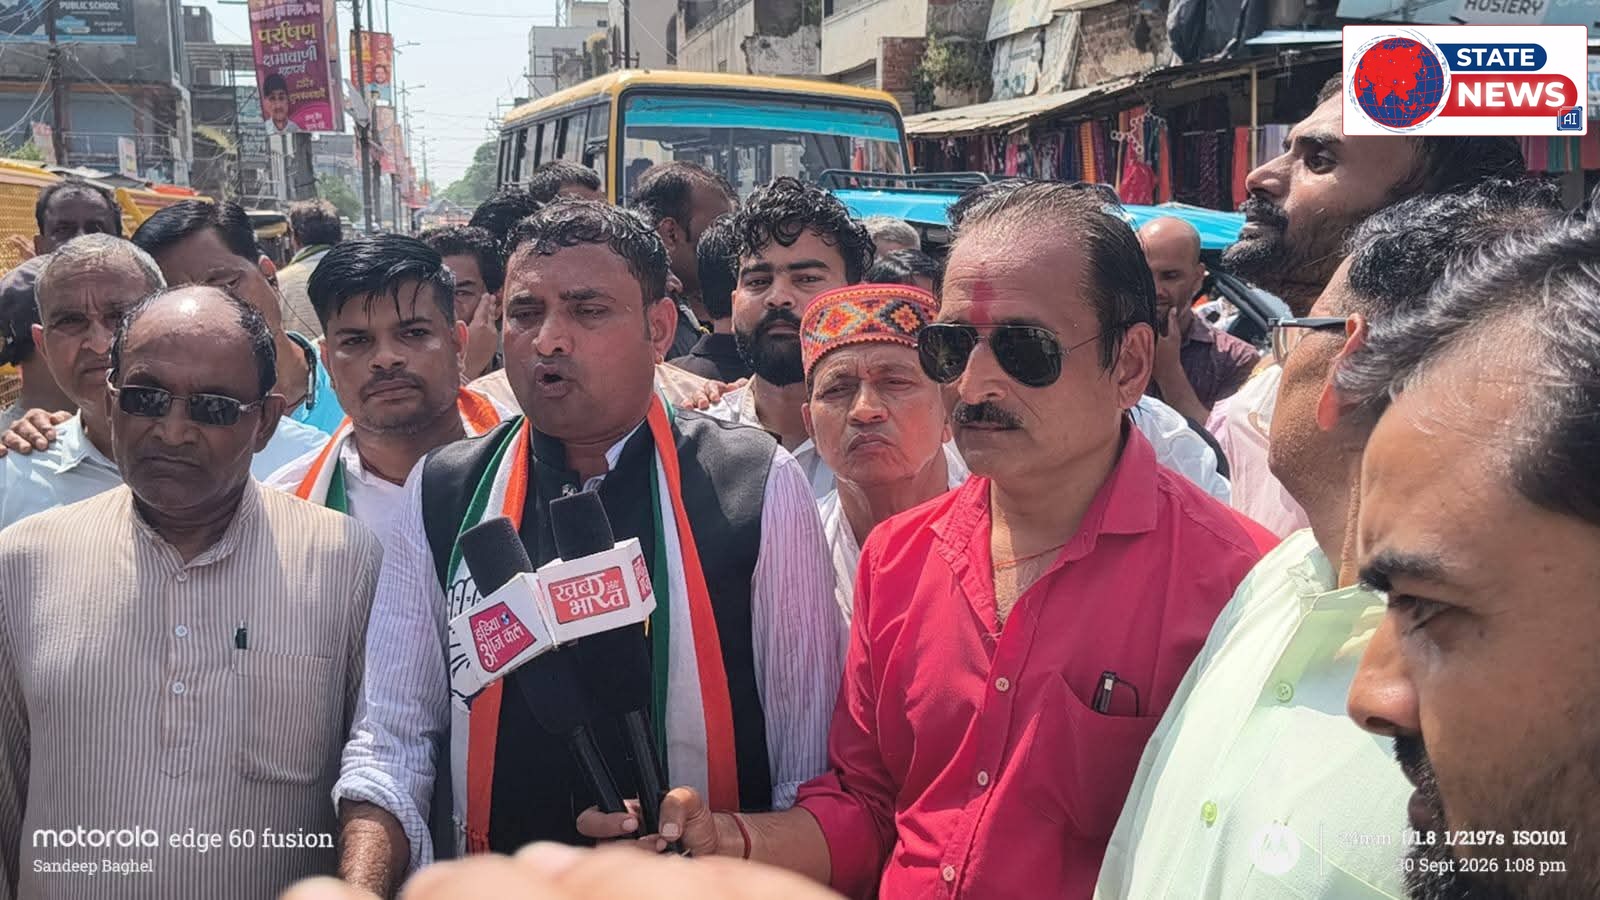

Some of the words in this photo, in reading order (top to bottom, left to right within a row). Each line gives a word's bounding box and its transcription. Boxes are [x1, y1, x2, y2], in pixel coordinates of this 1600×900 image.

[60, 1, 88, 10] PUBLIC
[89, 1, 120, 10] SCHOOL
[1464, 0, 1543, 15] HOSIERY
[570, 587, 625, 616] भारत
[479, 633, 505, 668] आज
[501, 621, 525, 643] कल
